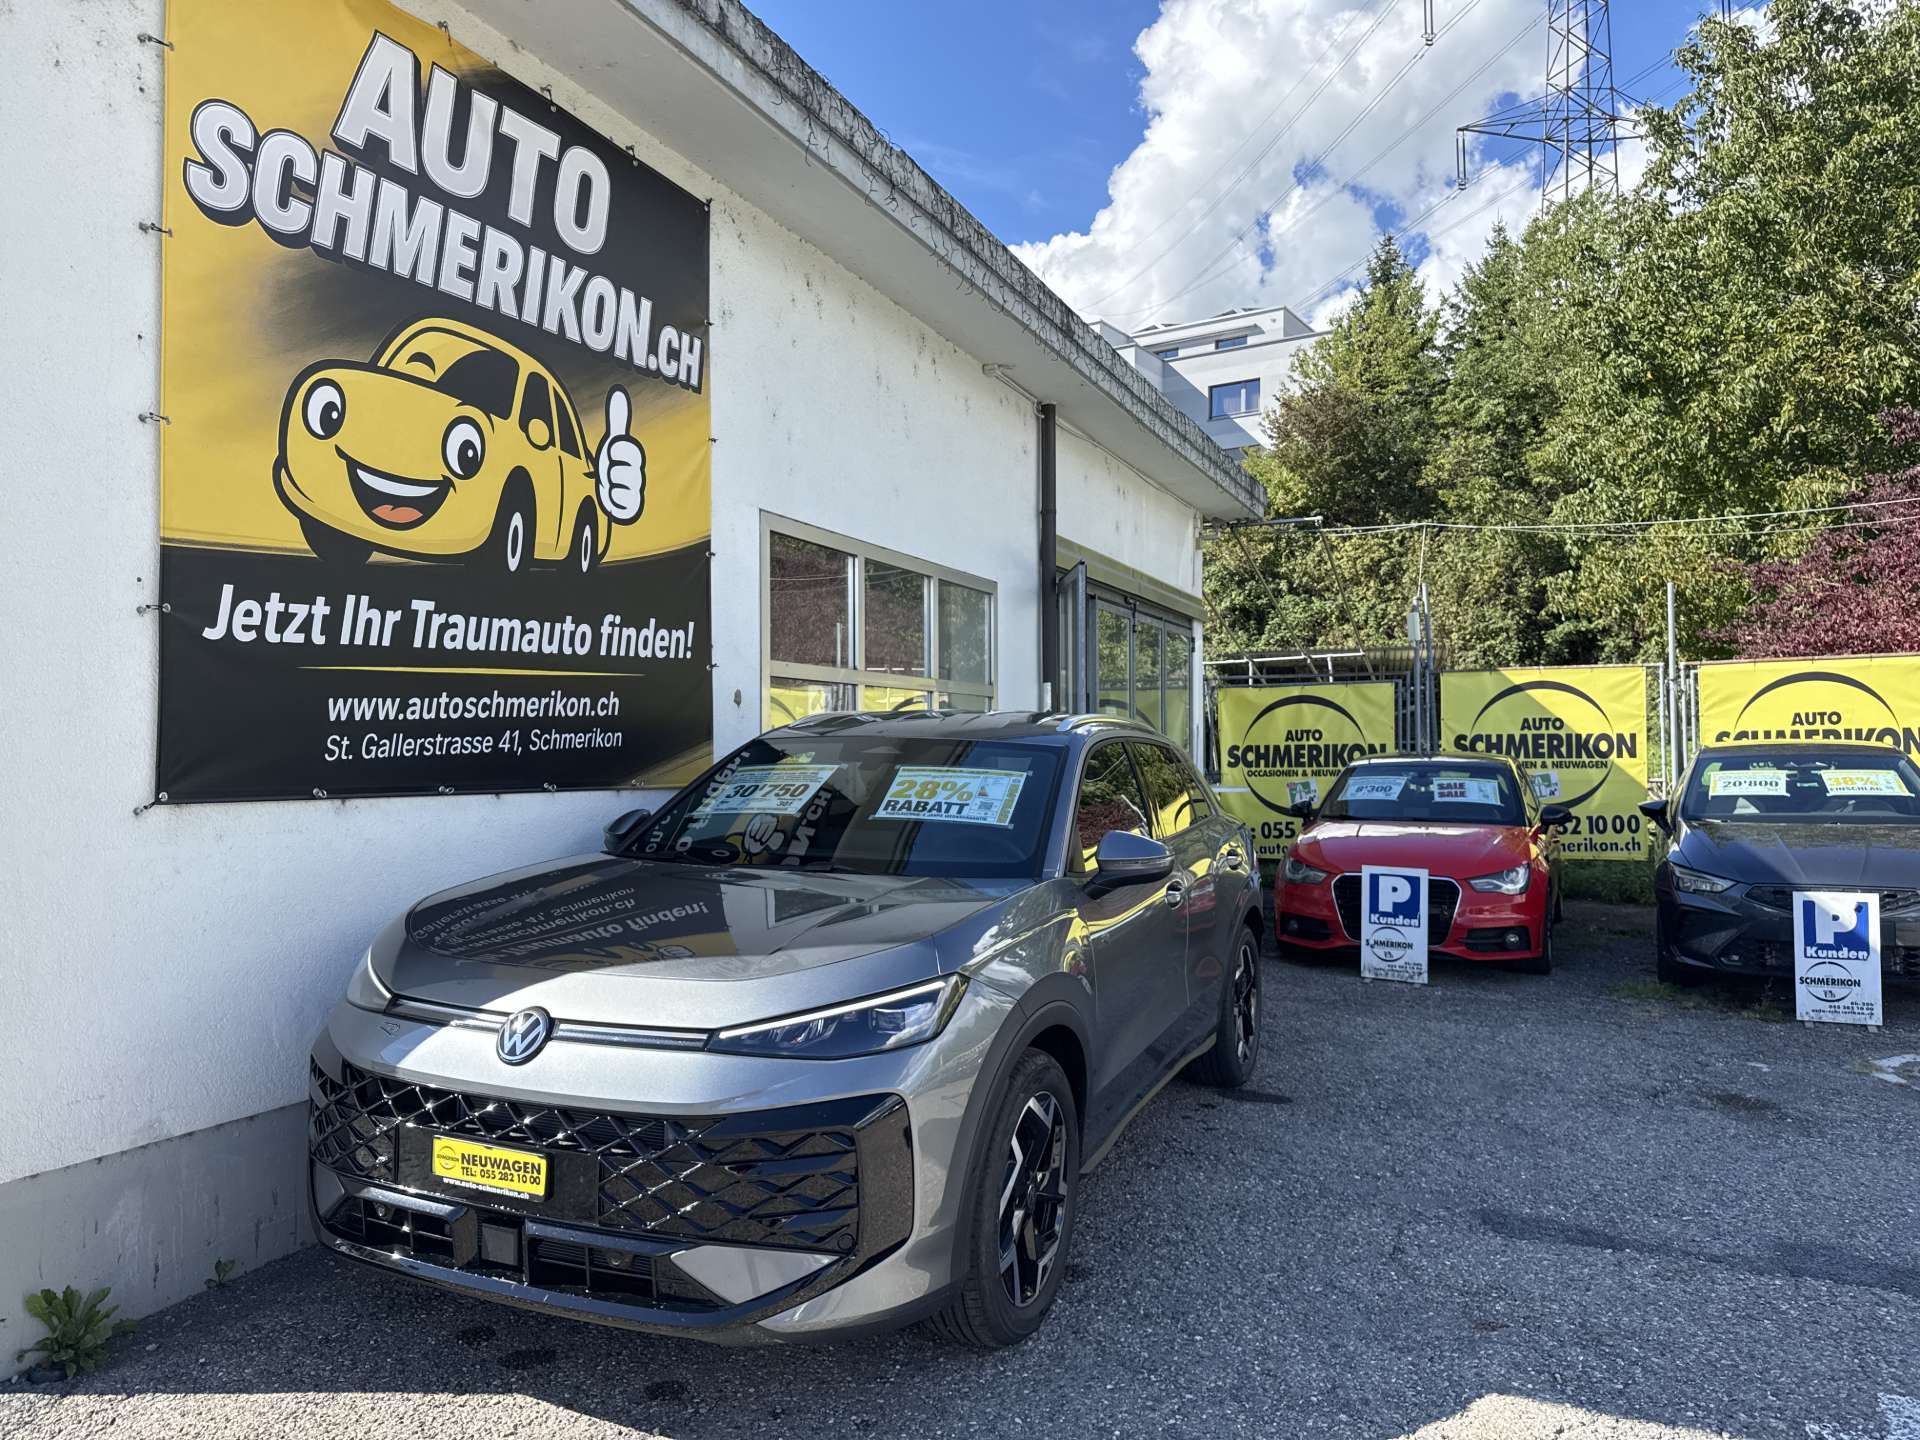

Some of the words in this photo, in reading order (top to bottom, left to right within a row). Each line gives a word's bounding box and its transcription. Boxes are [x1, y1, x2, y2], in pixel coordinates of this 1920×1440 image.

[332, 31, 611, 254] AUTO
[185, 101, 703, 389] SCHMERIKON.CH
[201, 583, 331, 645] Jetzt
[339, 594, 402, 647] Ihr
[409, 599, 592, 656] Traumauto
[600, 613, 695, 660] finden!
[327, 690, 620, 722] www.autoschmerikon.ch
[1520, 717, 1565, 731] AUTO
[1791, 711, 1842, 726] AUTO
[324, 734, 353, 762] St.
[360, 732, 493, 760] Gallerstrasse
[498, 731, 523, 756] 41,
[529, 728, 623, 751] Schmerikon
[1284, 729, 1323, 742] AUTO
[1454, 732, 1637, 759] SCHMERIKON
[1246, 769, 1299, 778] OCCASIONEN
[1302, 769, 1308, 777] &
[1540, 761, 1547, 769] &
[1552, 761, 1608, 769] NEUWAGEN
[725, 783, 810, 799] 30'750
[889, 779, 973, 801] 28%
[882, 799, 970, 815] RABATT
[1261, 821, 1296, 839] 055
[1586, 815, 1608, 835] 10
[1611, 814, 1640, 834] 00
[1378, 875, 1412, 913] P
[1370, 913, 1419, 928] Kunden
[1815, 902, 1857, 944] P
[1806, 946, 1868, 960] Kunden
[1799, 976, 1861, 987] SCHMERIKON
[461, 1153, 541, 1175] NEUWAGEN
[461, 1166, 477, 1177] TEL:
[480, 1169, 496, 1179] 055
[498, 1171, 514, 1182] 282
[517, 1174, 527, 1184] 10
[530, 1175, 541, 1185] 00
